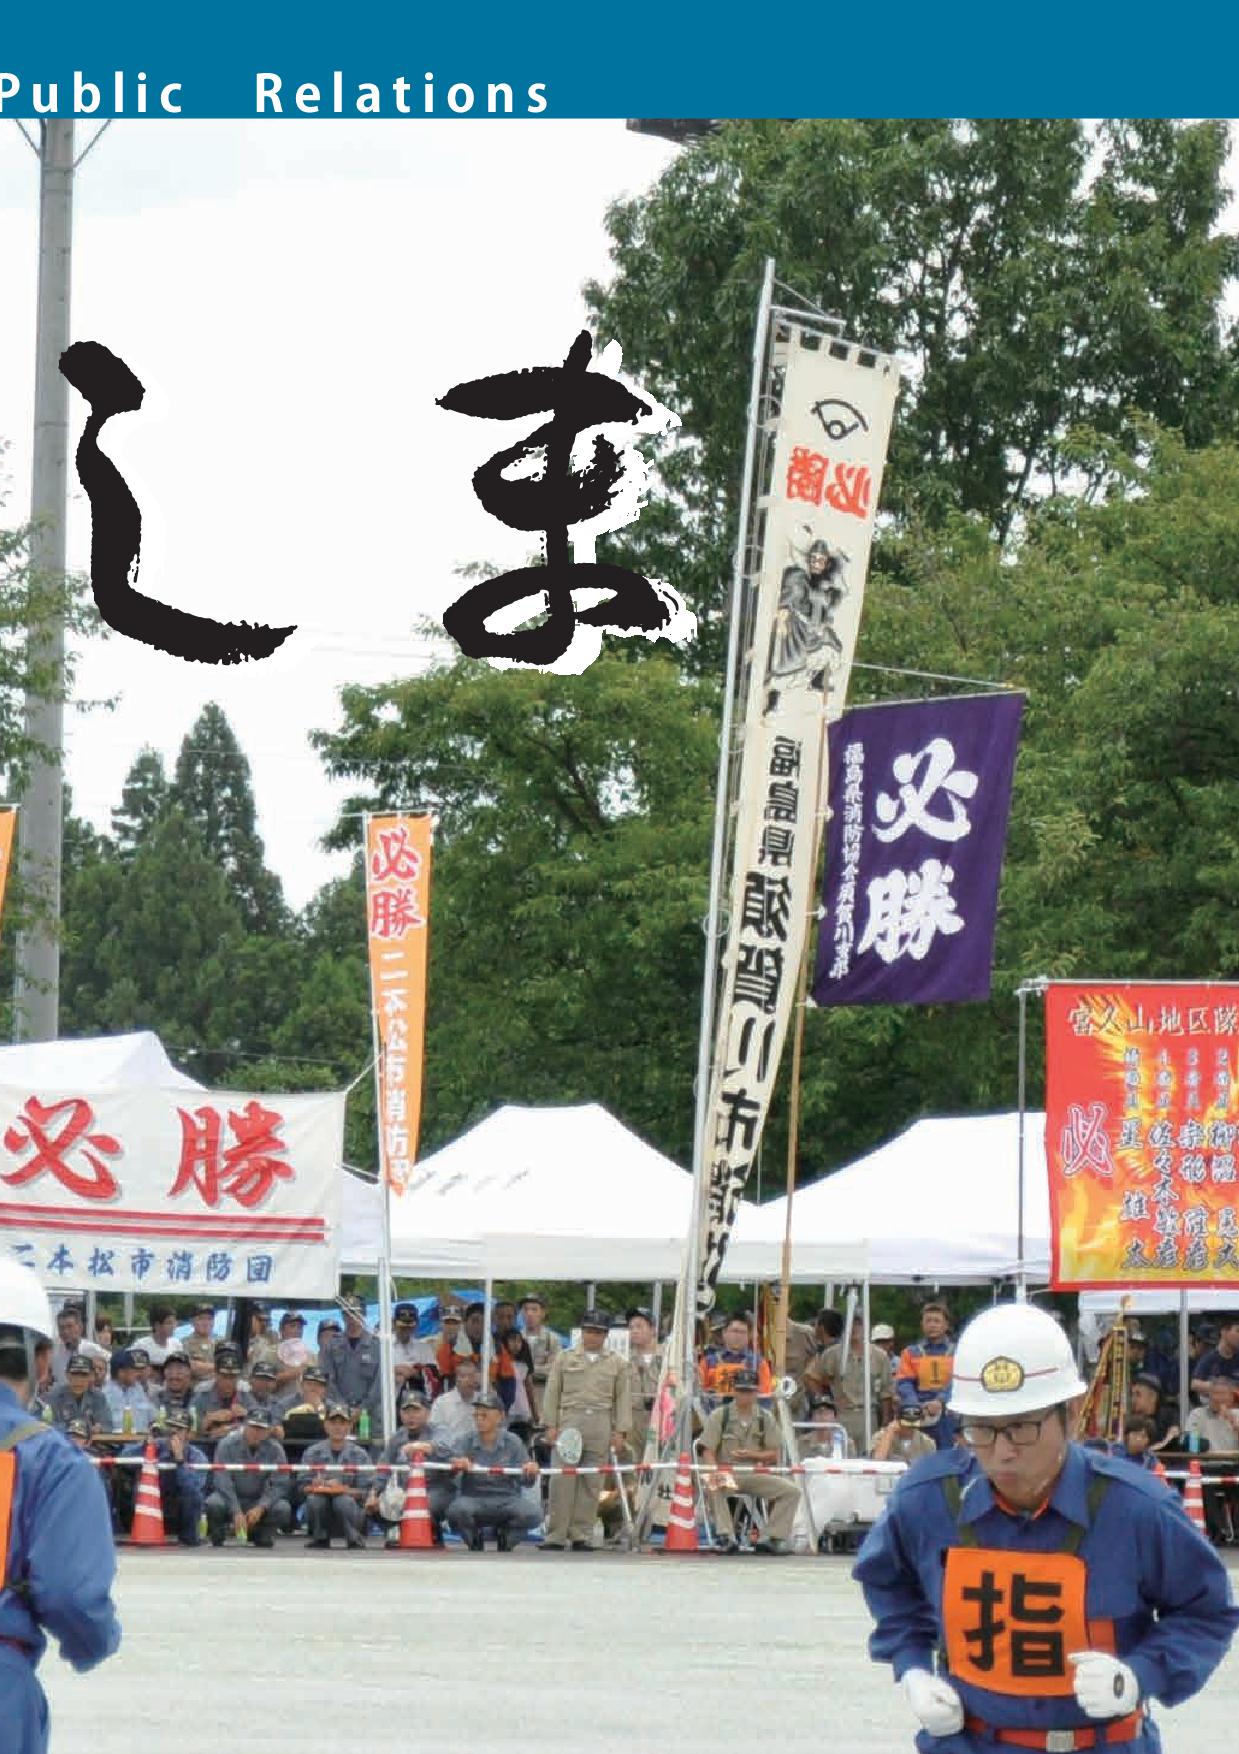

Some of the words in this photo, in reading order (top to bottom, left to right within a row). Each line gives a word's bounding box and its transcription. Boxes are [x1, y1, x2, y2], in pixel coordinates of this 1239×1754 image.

[370, 827, 423, 938] 必勝
[858, 737, 980, 964] 必勝
[10, 1244, 274, 1284] 二本松市消防団
[962, 1570, 1065, 1677] 指
